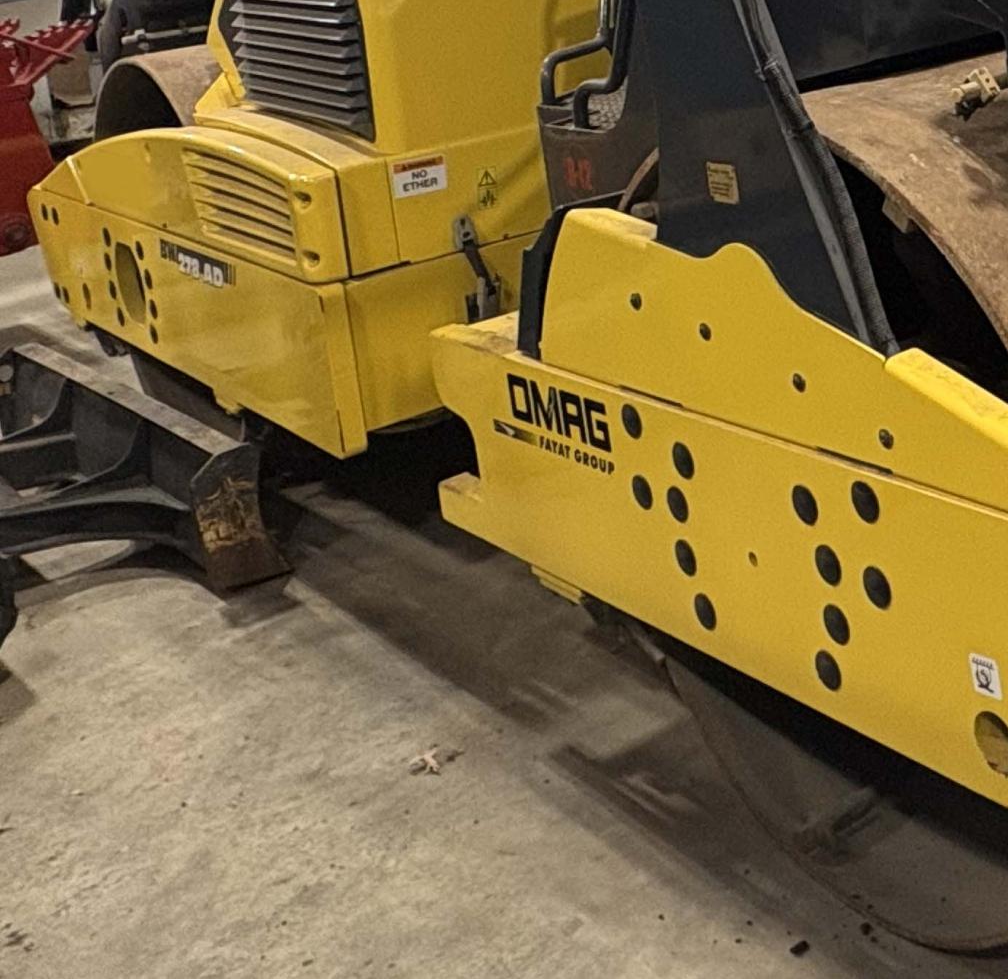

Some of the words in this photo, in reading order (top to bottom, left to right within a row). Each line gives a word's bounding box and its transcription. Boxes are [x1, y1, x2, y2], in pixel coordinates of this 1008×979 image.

[411, 169, 428, 181] NO
[402, 177, 438, 192] ETHER
[539, 435, 571, 459] FAYAT
[574, 448, 615, 475] GROUP
